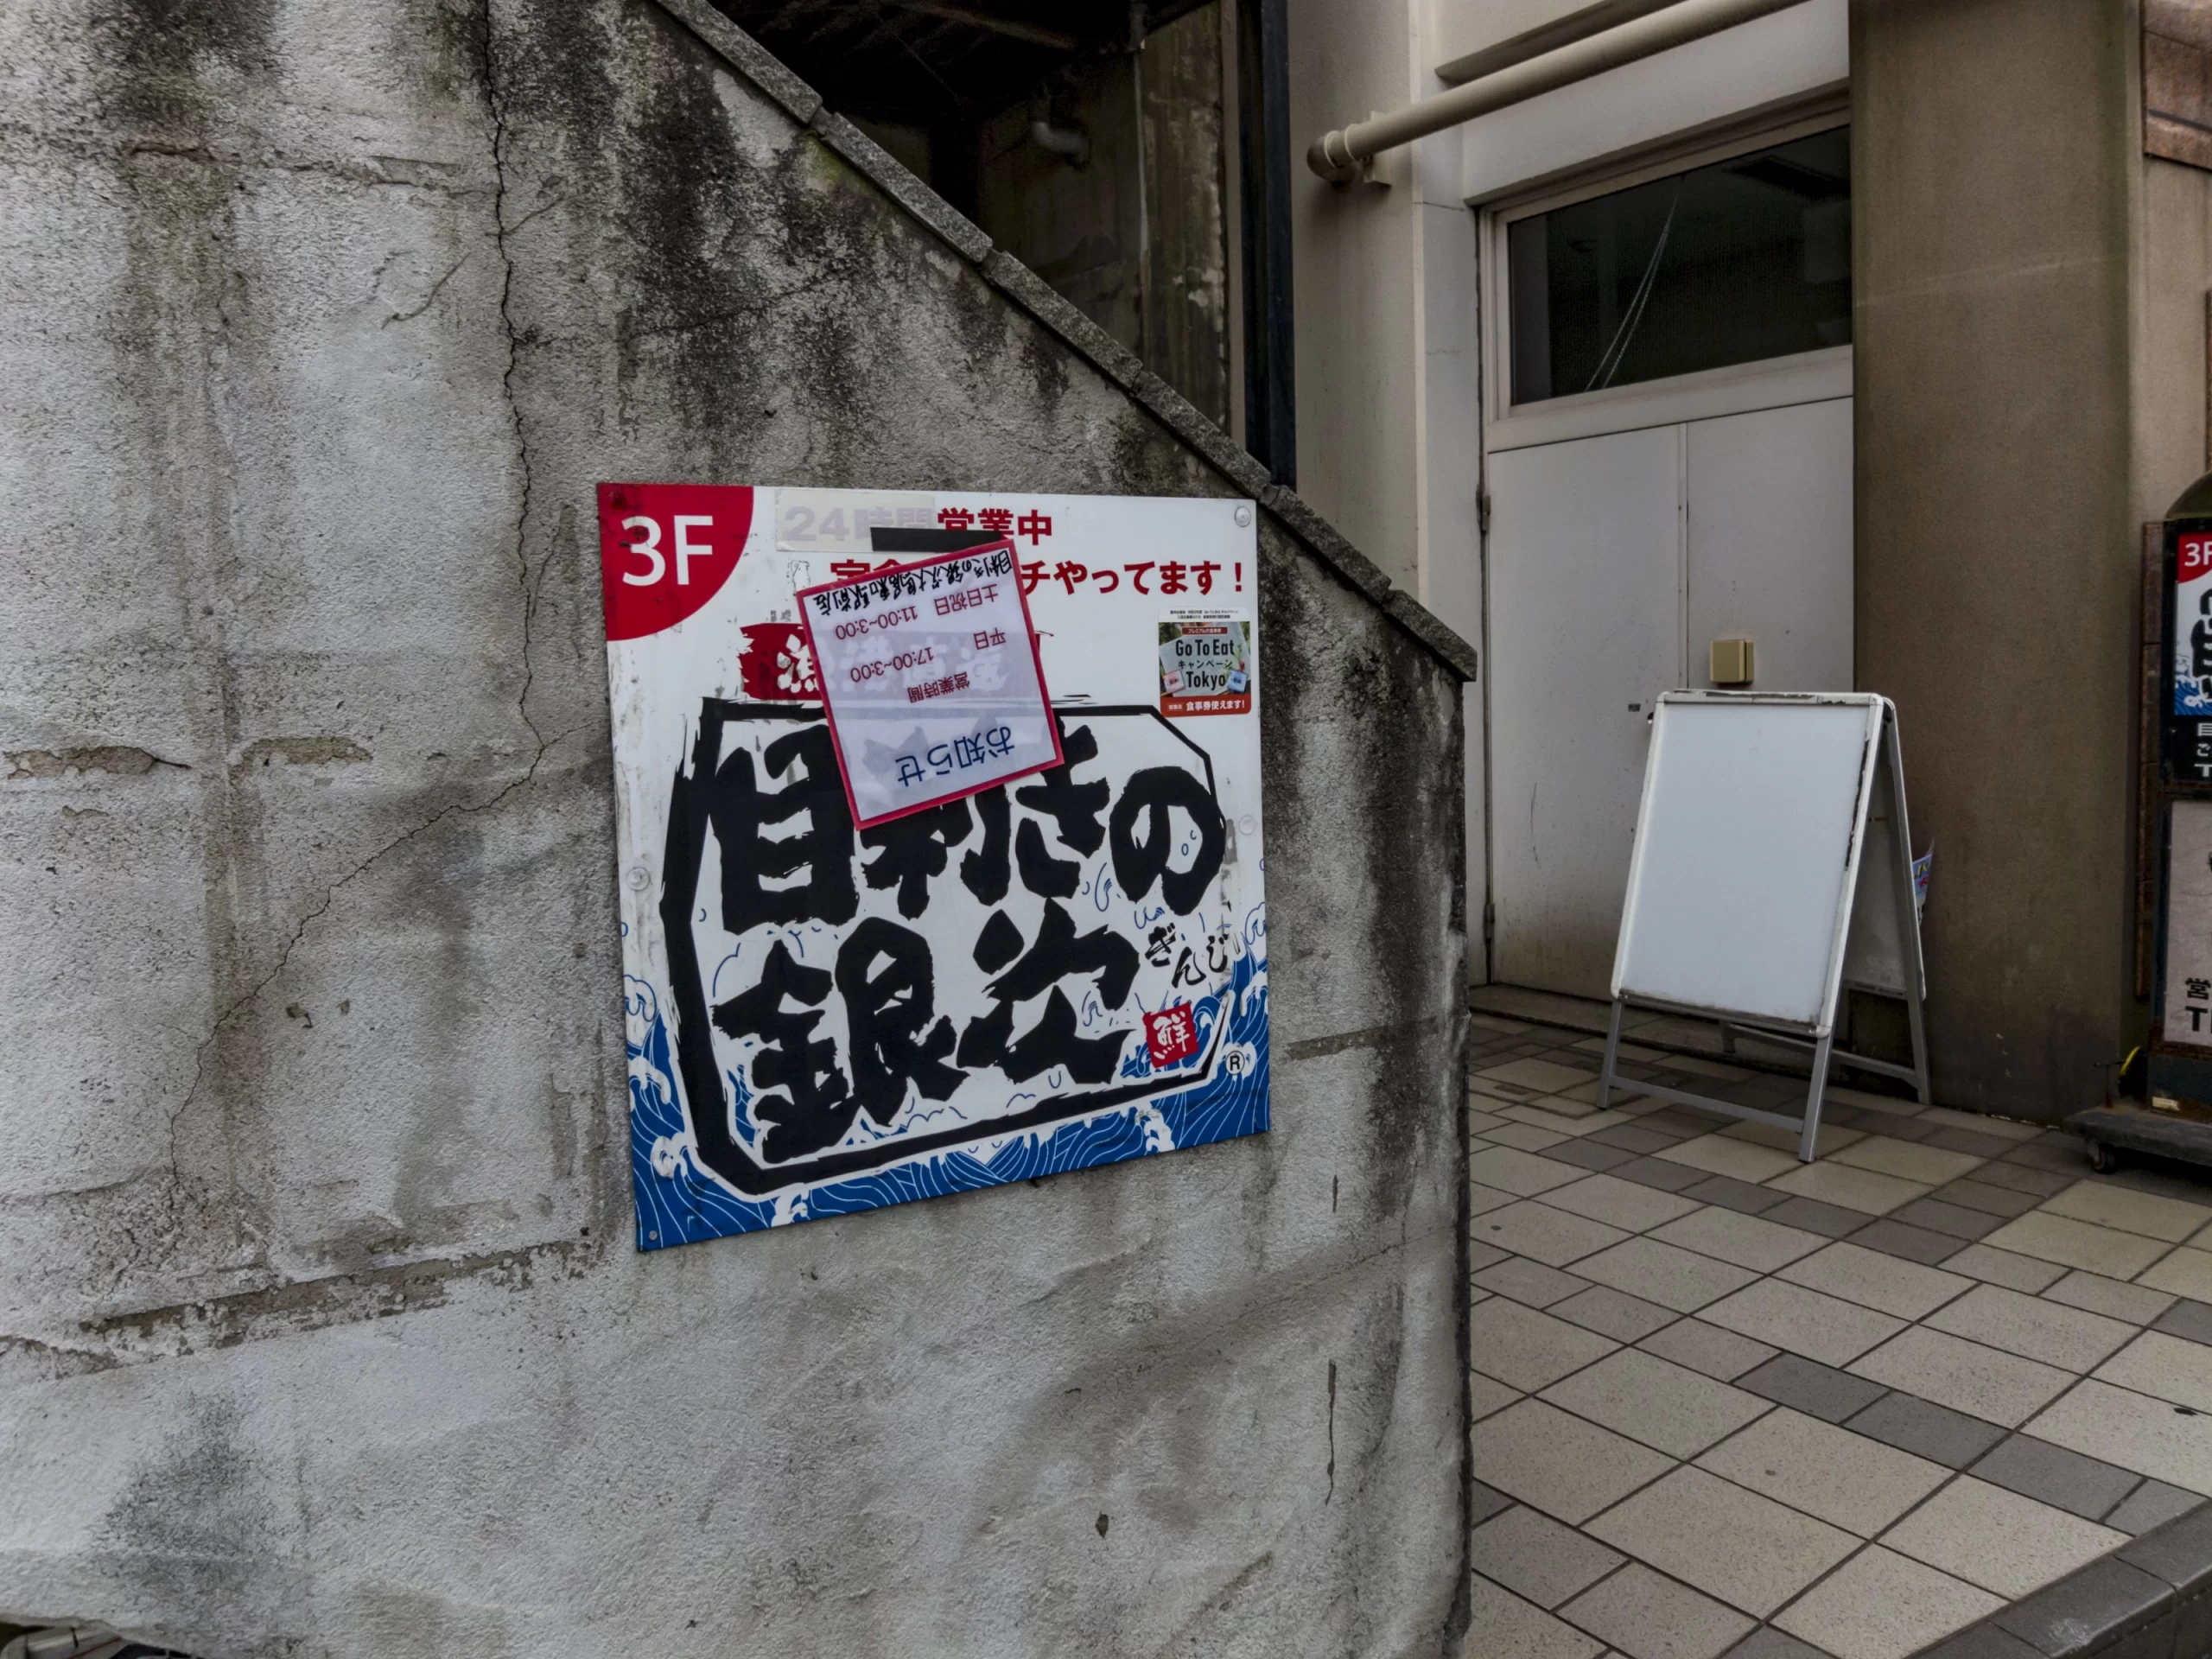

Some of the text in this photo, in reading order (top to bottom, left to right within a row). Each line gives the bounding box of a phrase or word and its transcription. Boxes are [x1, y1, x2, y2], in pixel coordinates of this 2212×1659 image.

[621, 515, 714, 587] 3F
[934, 583, 999, 616] 土日祝日
[974, 627, 1007, 650] 平日
[1176, 639, 1235, 657] Go To Eat
[1178, 659, 1233, 670] キャンペーン
[907, 671, 970, 703] 営業時間
[1185, 671, 1226, 691] Tokyo
[895, 727, 1014, 787] お知らせ
[1145, 923, 1230, 988] ぎんじ
